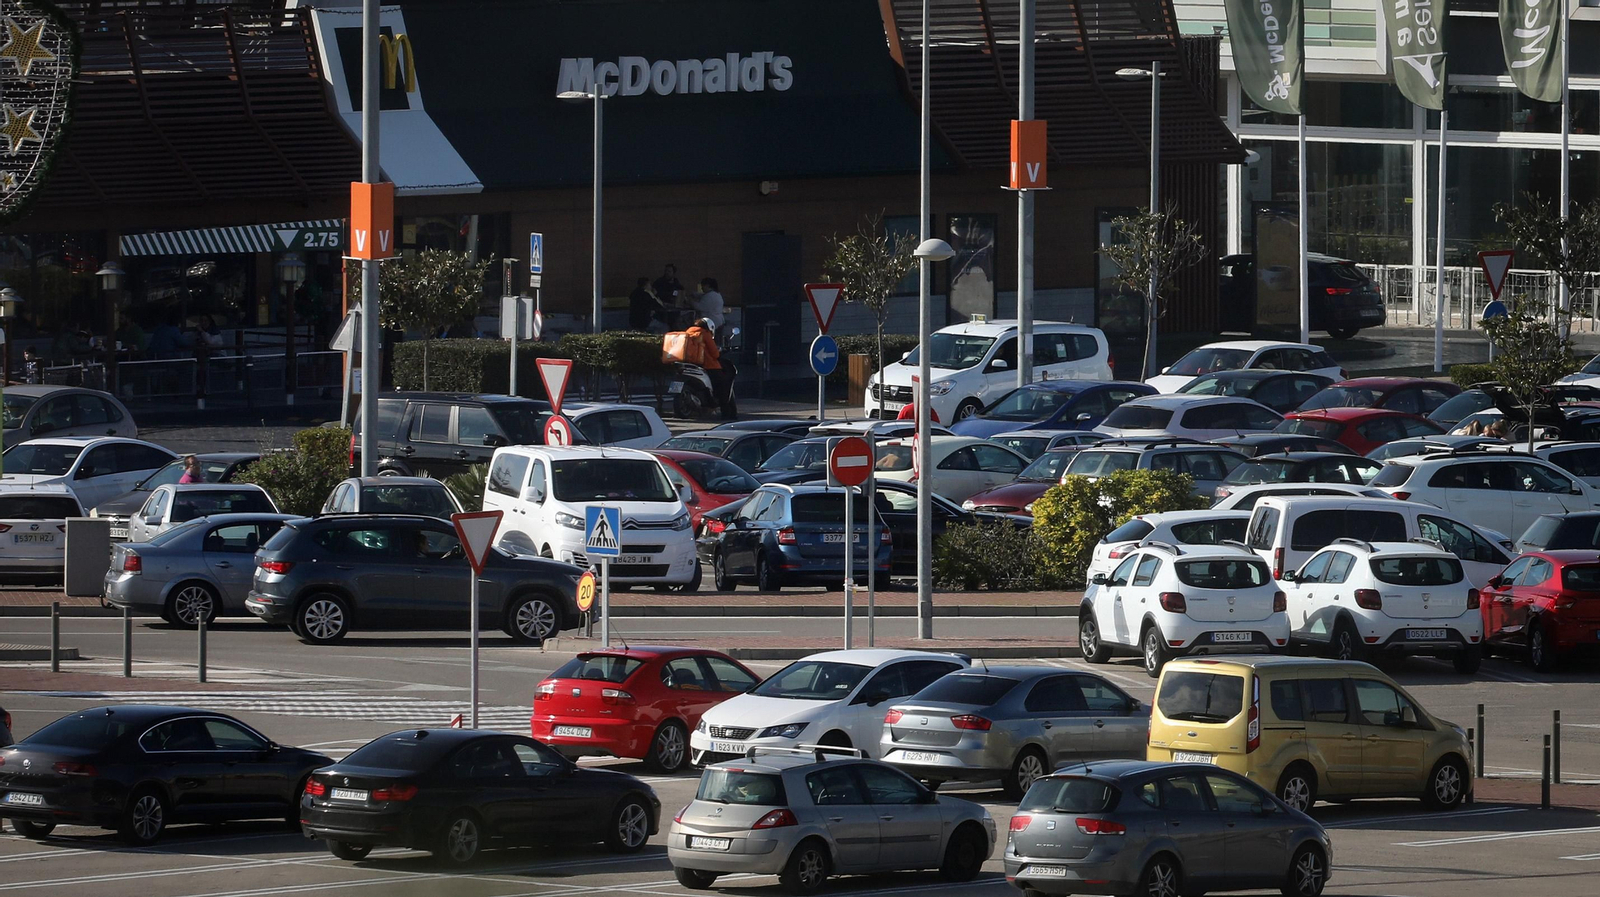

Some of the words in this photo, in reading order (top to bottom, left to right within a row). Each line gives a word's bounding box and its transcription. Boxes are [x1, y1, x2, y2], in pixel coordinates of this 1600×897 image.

[556, 51, 794, 97] McDonald's
[1026, 162, 1041, 183] V
[303, 231, 339, 248] 2.75
[355, 229, 367, 252] V
[378, 229, 390, 252] V
[19, 534, 37, 543] 5371
[40, 534, 54, 542] HZJ
[824, 534, 843, 542] 3377
[580, 584, 592, 600] 20
[1236, 632, 1251, 641] KJT
[1410, 630, 1430, 638] 0522
[715, 743, 731, 752] 1623
